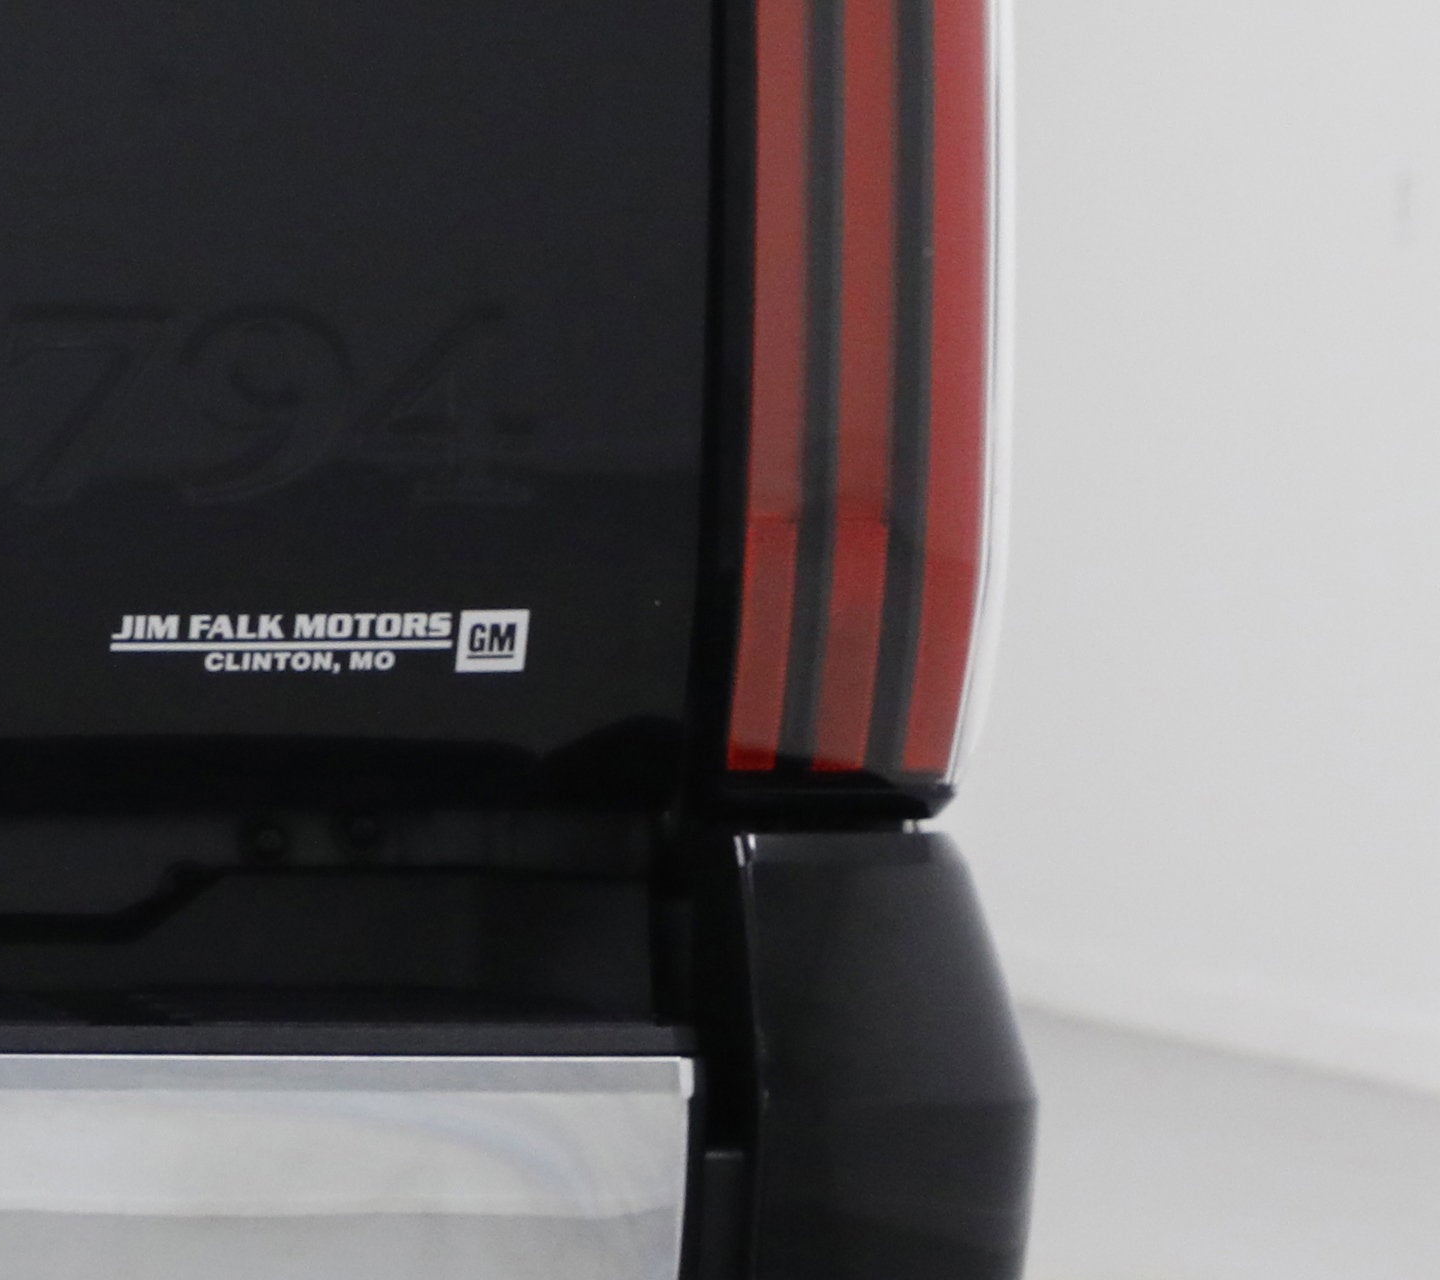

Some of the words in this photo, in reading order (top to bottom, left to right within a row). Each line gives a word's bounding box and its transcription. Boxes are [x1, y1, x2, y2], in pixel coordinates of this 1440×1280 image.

[110, 614, 180, 640] JIM
[188, 614, 285, 640] FALK
[293, 611, 452, 640] MOTORS
[467, 622, 517, 654] GM
[203, 650, 341, 675] CLINTON,
[348, 649, 397, 671] MO
